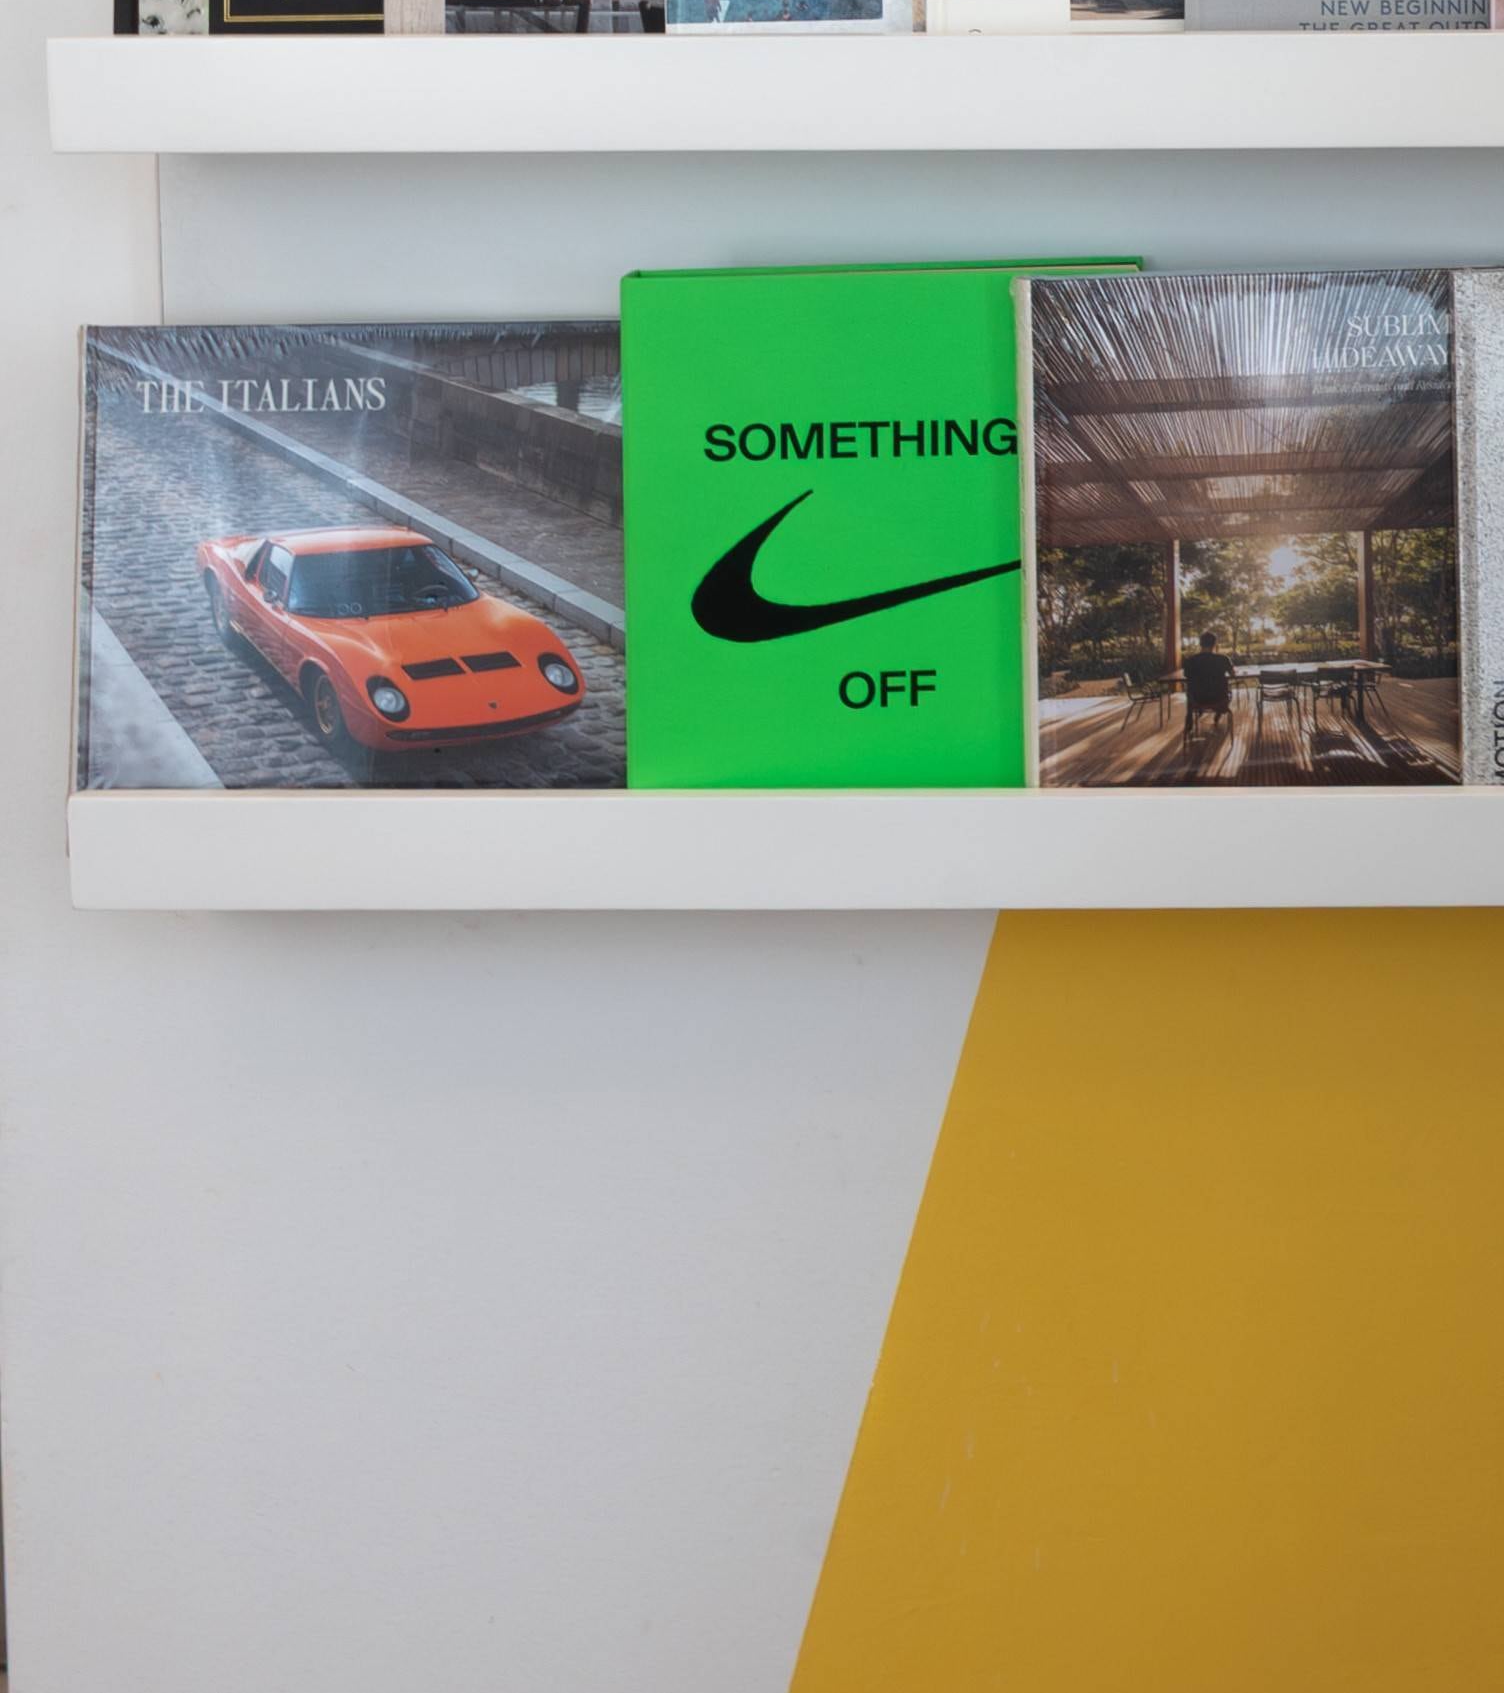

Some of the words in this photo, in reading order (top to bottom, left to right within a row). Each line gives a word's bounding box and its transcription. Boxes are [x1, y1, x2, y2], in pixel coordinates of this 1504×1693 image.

[1320, 0, 1371, 16] NEW
[137, 379, 205, 414] THE
[218, 376, 387, 413] ITALIANS
[704, 418, 1018, 462] SOMETHING
[837, 668, 937, 710] OFF
